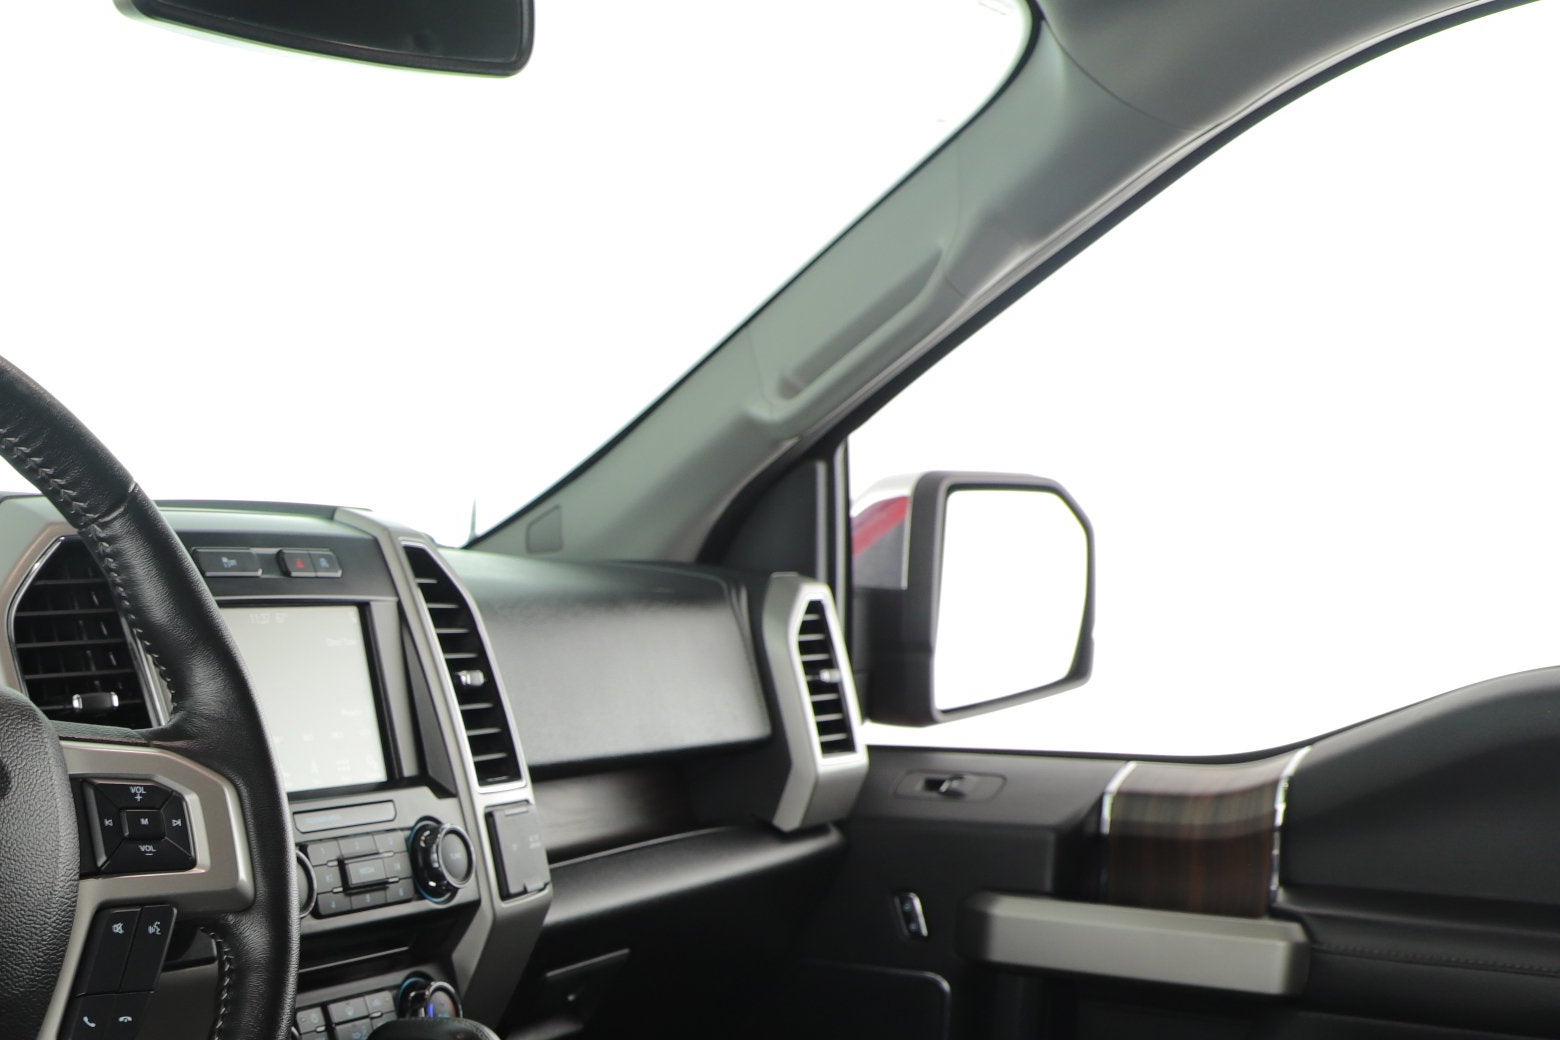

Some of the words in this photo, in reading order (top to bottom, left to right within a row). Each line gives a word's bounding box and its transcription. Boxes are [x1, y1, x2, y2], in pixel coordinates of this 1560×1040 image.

[129, 785, 148, 794] VOL
[140, 817, 149, 826] M
[138, 844, 157, 853] VOL
